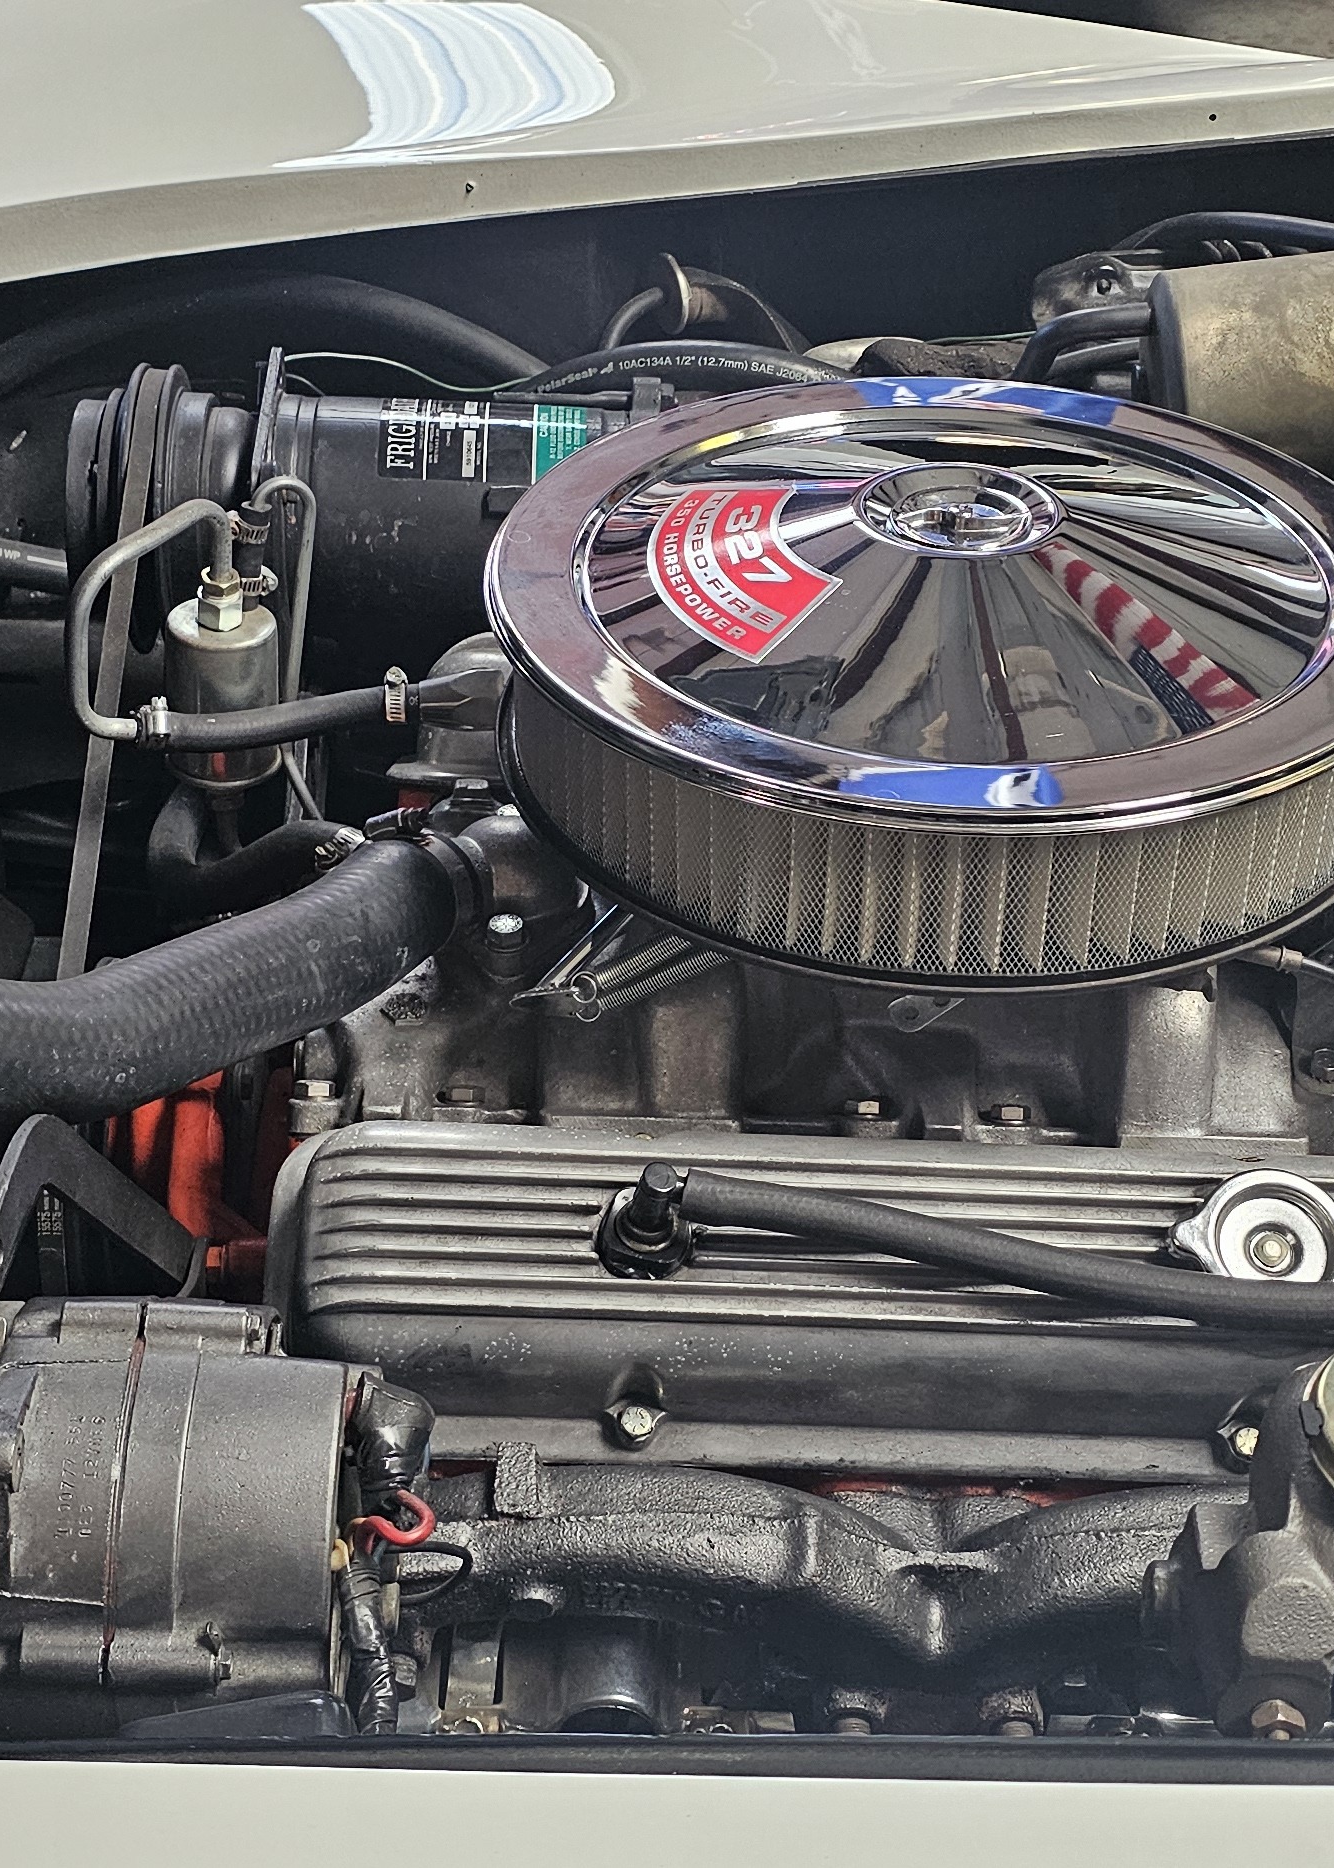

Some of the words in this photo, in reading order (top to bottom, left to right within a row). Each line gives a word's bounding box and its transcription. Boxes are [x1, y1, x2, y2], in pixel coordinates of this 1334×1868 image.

[618, 356, 672, 371] 10AC134A
[698, 356, 748, 371] (12.7mm)
[750, 361, 774, 375] SAE
[669, 498, 700, 528] 350
[3, 548, 21, 560] WP
[691, 493, 774, 627] TURBO-FIRE
[725, 504, 793, 584] 327
[662, 532, 747, 640] HORSEPOWER
